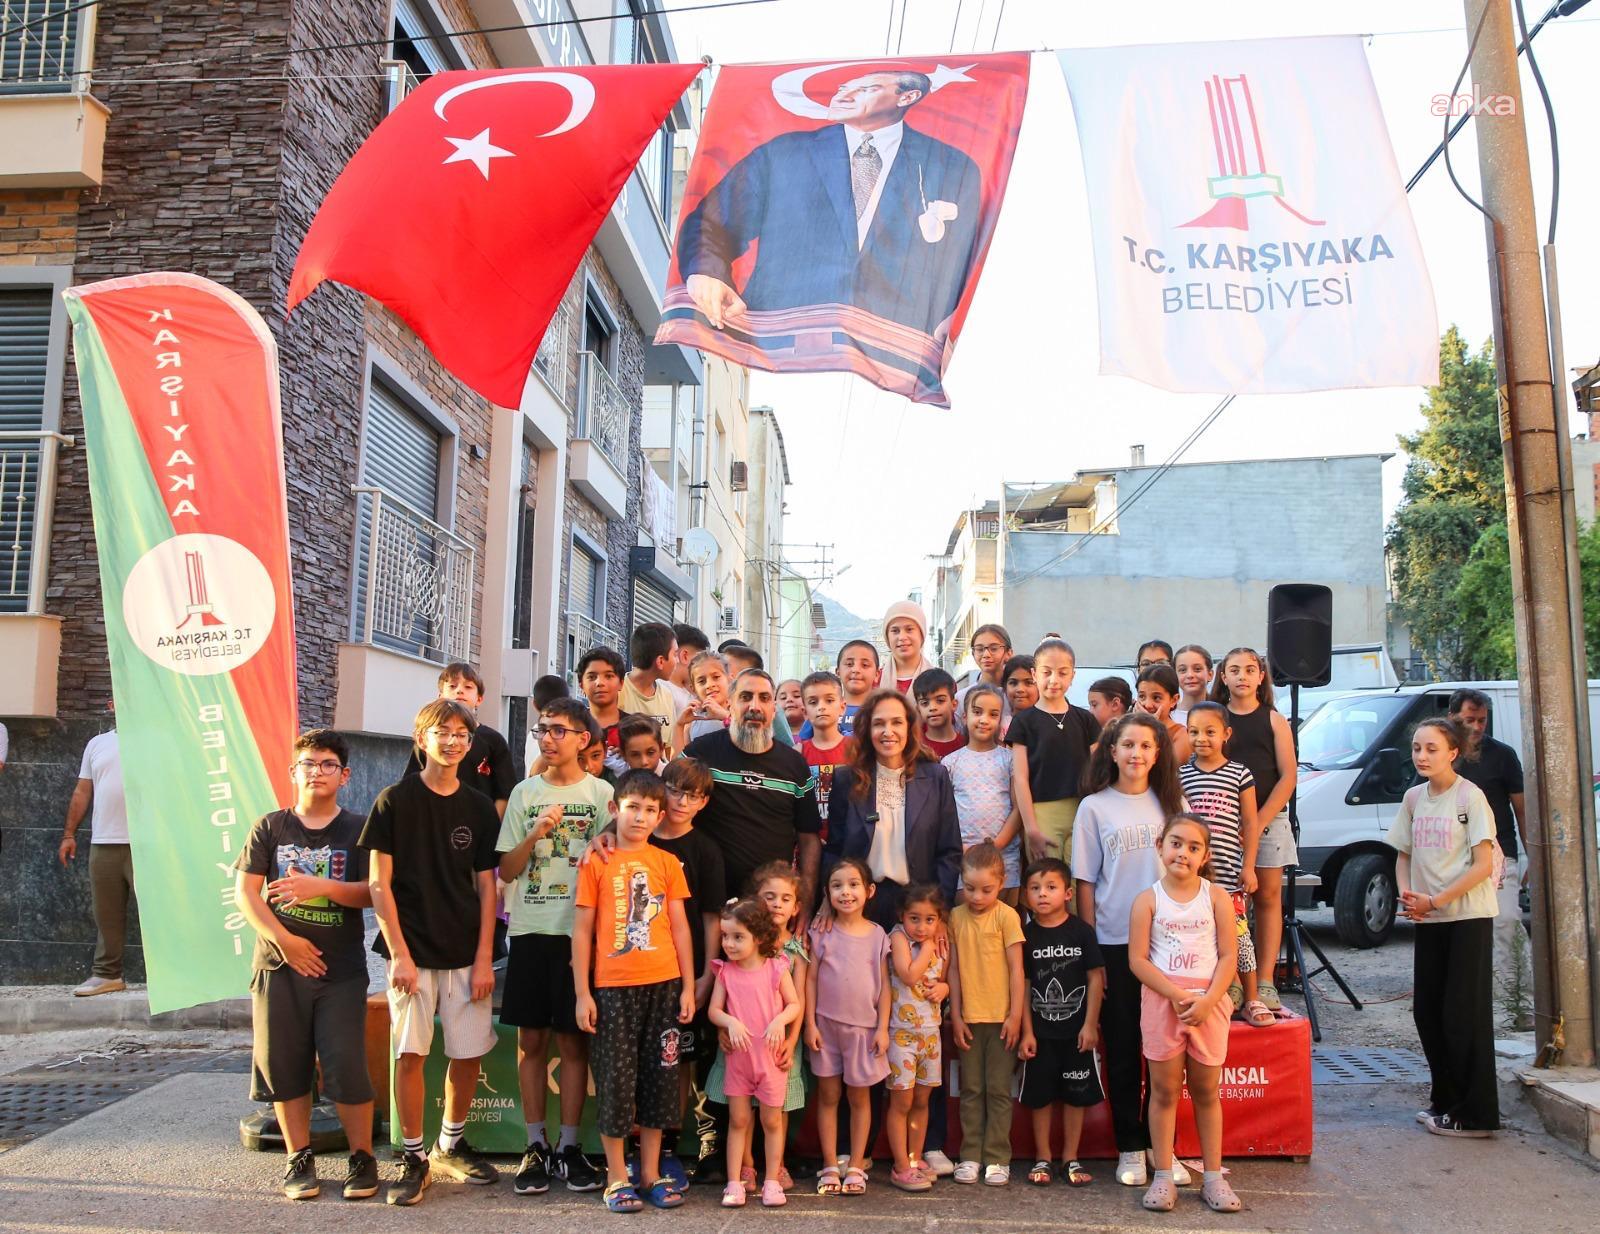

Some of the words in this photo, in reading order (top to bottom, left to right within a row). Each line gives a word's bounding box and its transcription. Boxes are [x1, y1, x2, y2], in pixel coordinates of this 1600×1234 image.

[1122, 235, 1176, 274] T.C.
[1187, 234, 1394, 274] KARŞIYAKA
[1162, 272, 1353, 314] BELEDİYESİ
[615, 899, 627, 919] FOR
[1032, 944, 1082, 959] adidas
[1168, 952, 1200, 972] LOVE
[470, 1097, 516, 1110] RŞIYAKA
[1226, 1088, 1265, 1102] BAŞKANI
